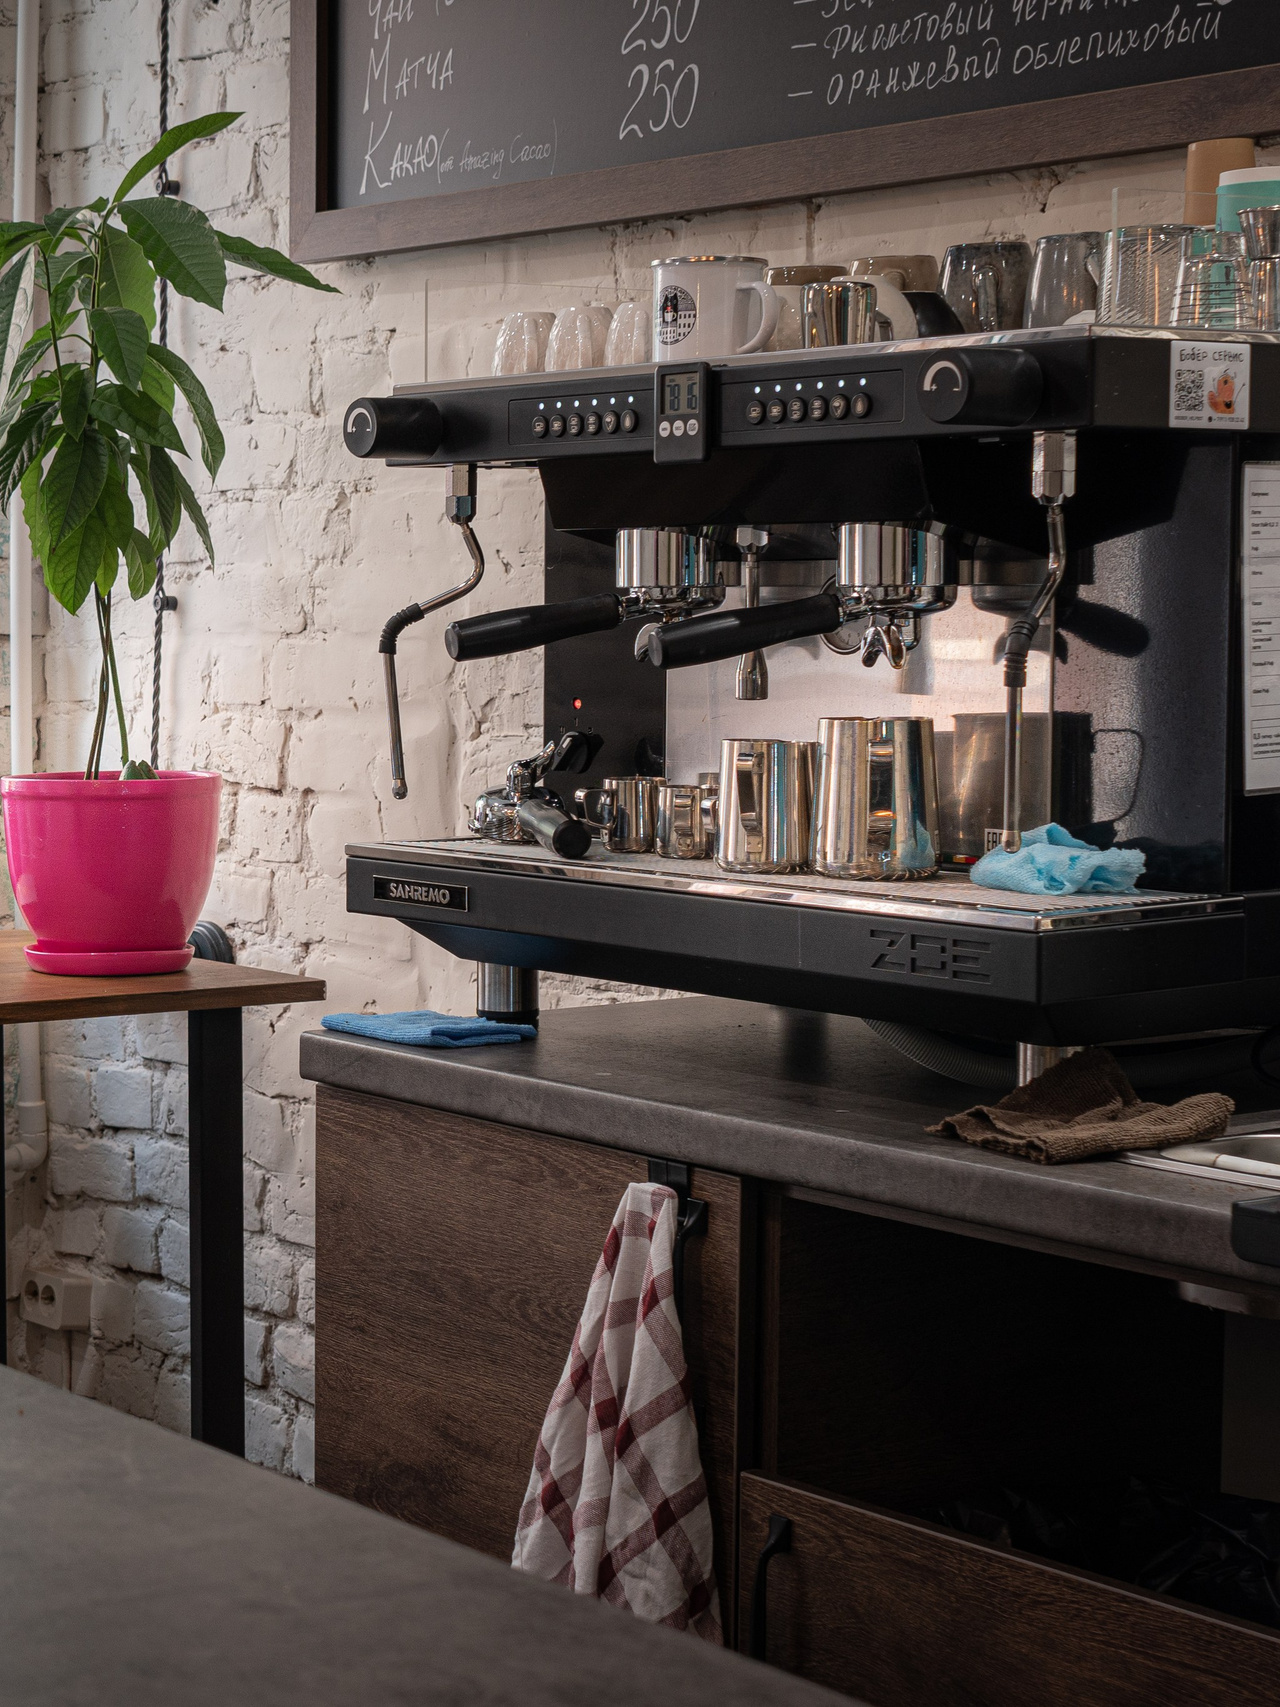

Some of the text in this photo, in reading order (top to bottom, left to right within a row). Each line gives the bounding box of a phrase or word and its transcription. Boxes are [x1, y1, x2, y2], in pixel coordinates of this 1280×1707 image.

[618, 58, 700, 141] 250
[389, 882, 451, 905] SANREMO
[869, 929, 992, 985] ZOE
